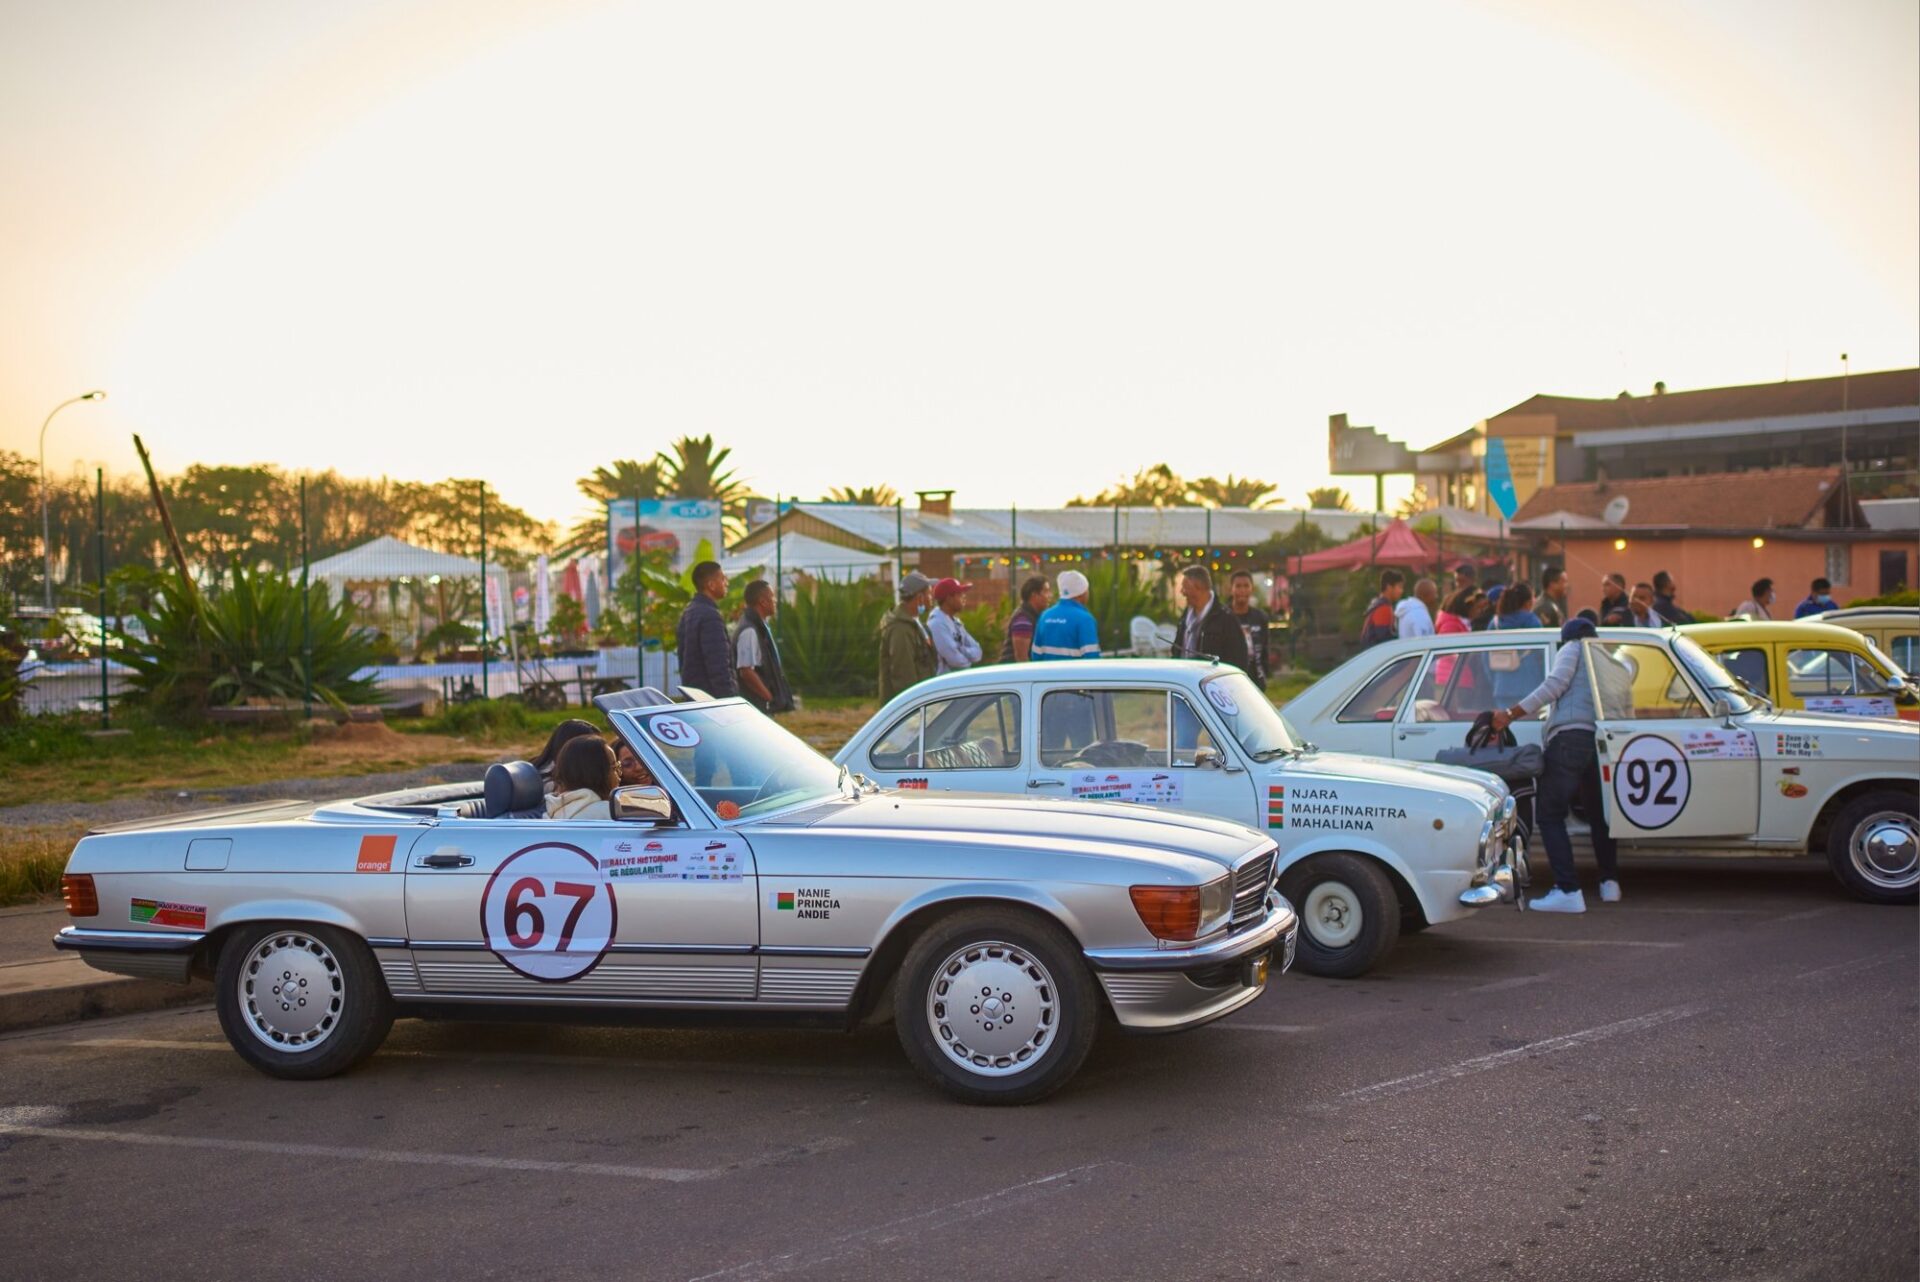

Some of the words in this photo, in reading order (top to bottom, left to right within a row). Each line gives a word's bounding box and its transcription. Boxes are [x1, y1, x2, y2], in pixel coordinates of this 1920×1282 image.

[656, 722, 690, 740] 67
[1627, 758, 1678, 806] 92
[1291, 789, 1338, 800] NJARA
[1291, 804, 1407, 819] MAHAFINARITRA
[1291, 818, 1374, 831] MAHALIANA
[609, 857, 635, 866] RALLYE
[637, 854, 678, 865] HISTORIQUE
[357, 862, 388, 872] orange
[609, 869, 619, 877] DE
[620, 863, 663, 876] RÉGULARITÉ
[798, 889, 830, 898] NANIE
[798, 899, 840, 909] PRINCIA
[504, 877, 596, 952] 67
[797, 910, 830, 919] ANDIE
